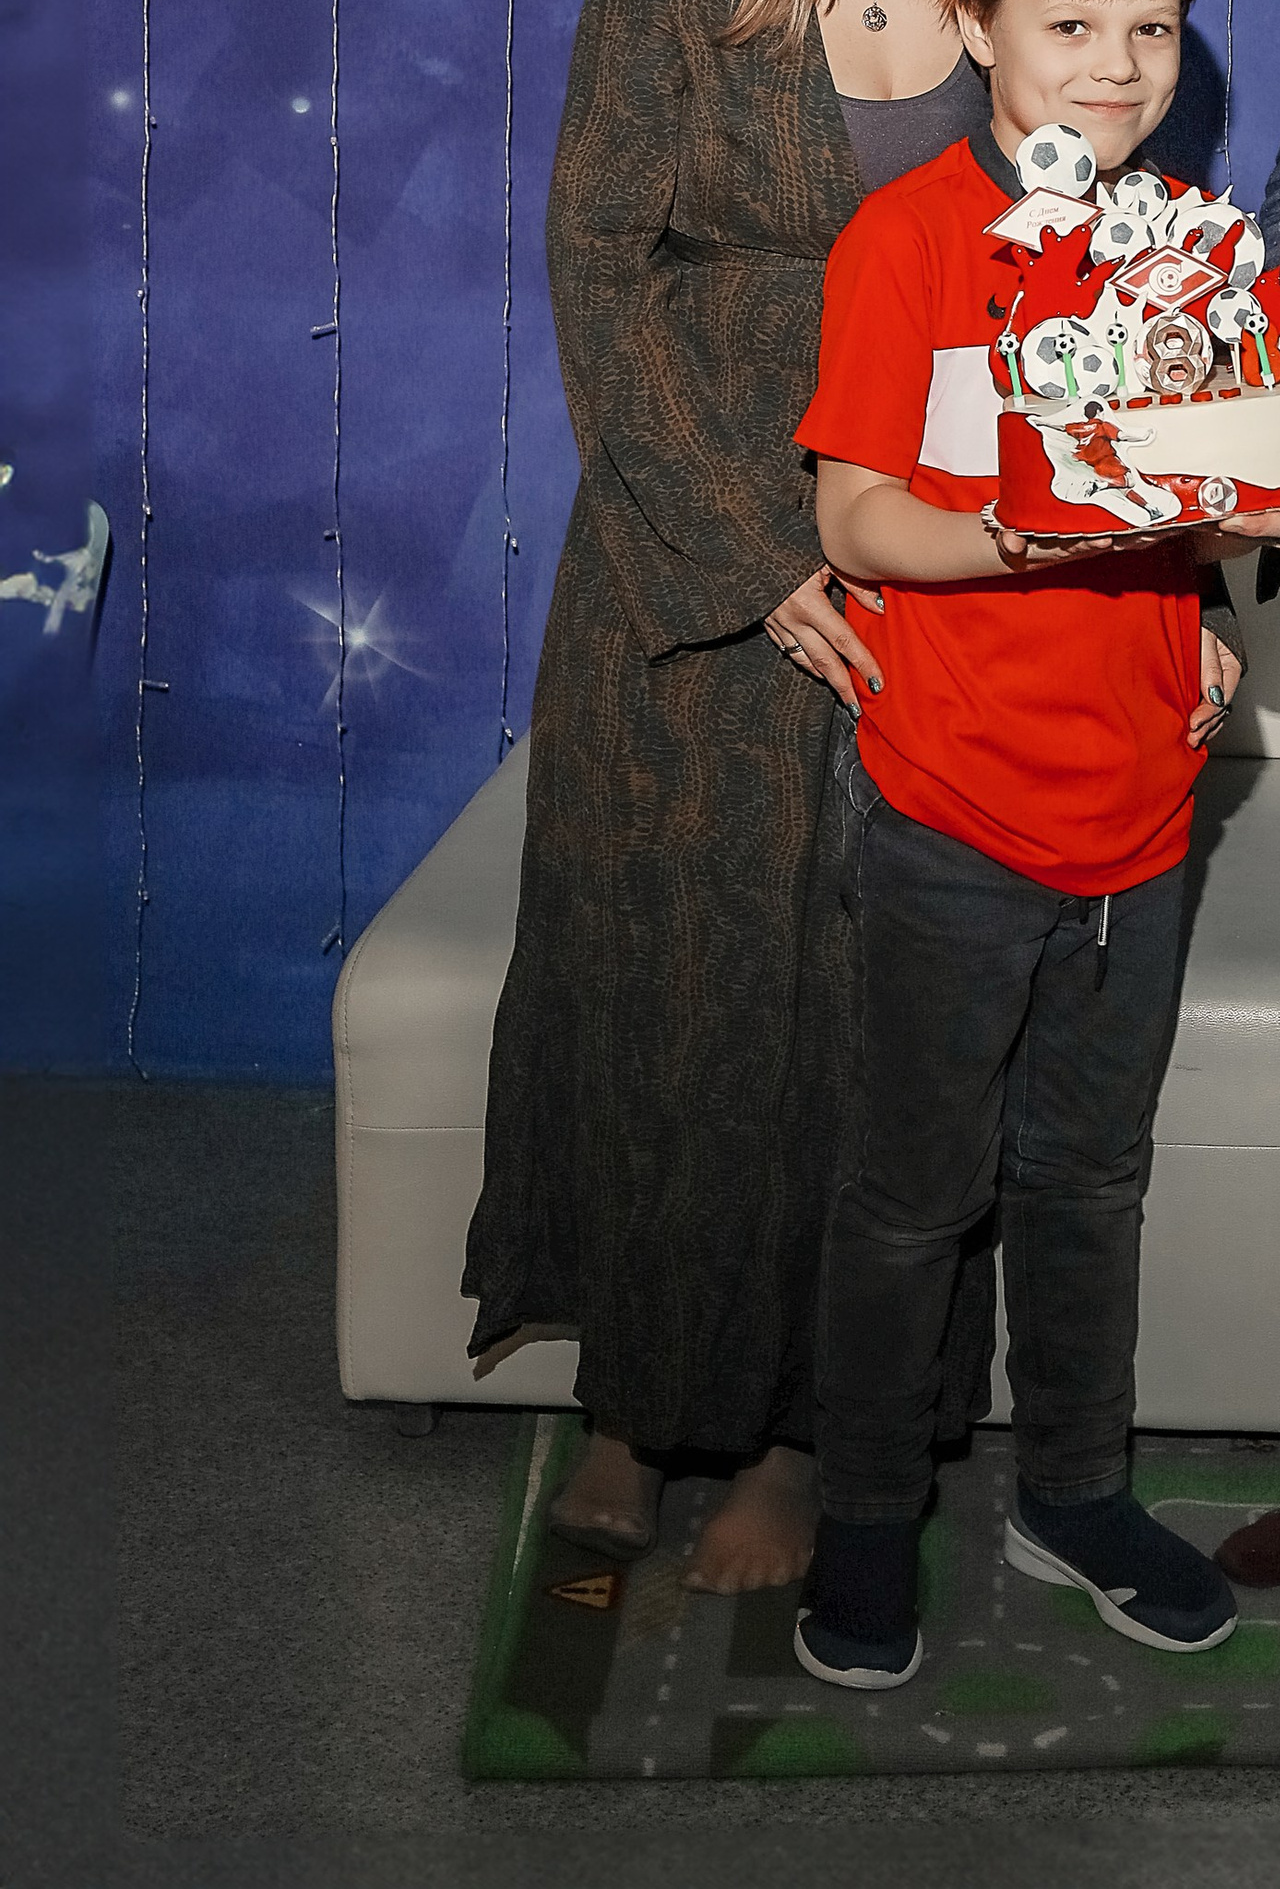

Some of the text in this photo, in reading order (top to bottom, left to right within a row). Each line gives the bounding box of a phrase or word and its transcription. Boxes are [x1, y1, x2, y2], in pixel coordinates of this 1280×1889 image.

[1029, 207, 1059, 218] С Днем
[1146, 314, 1206, 395] 8
